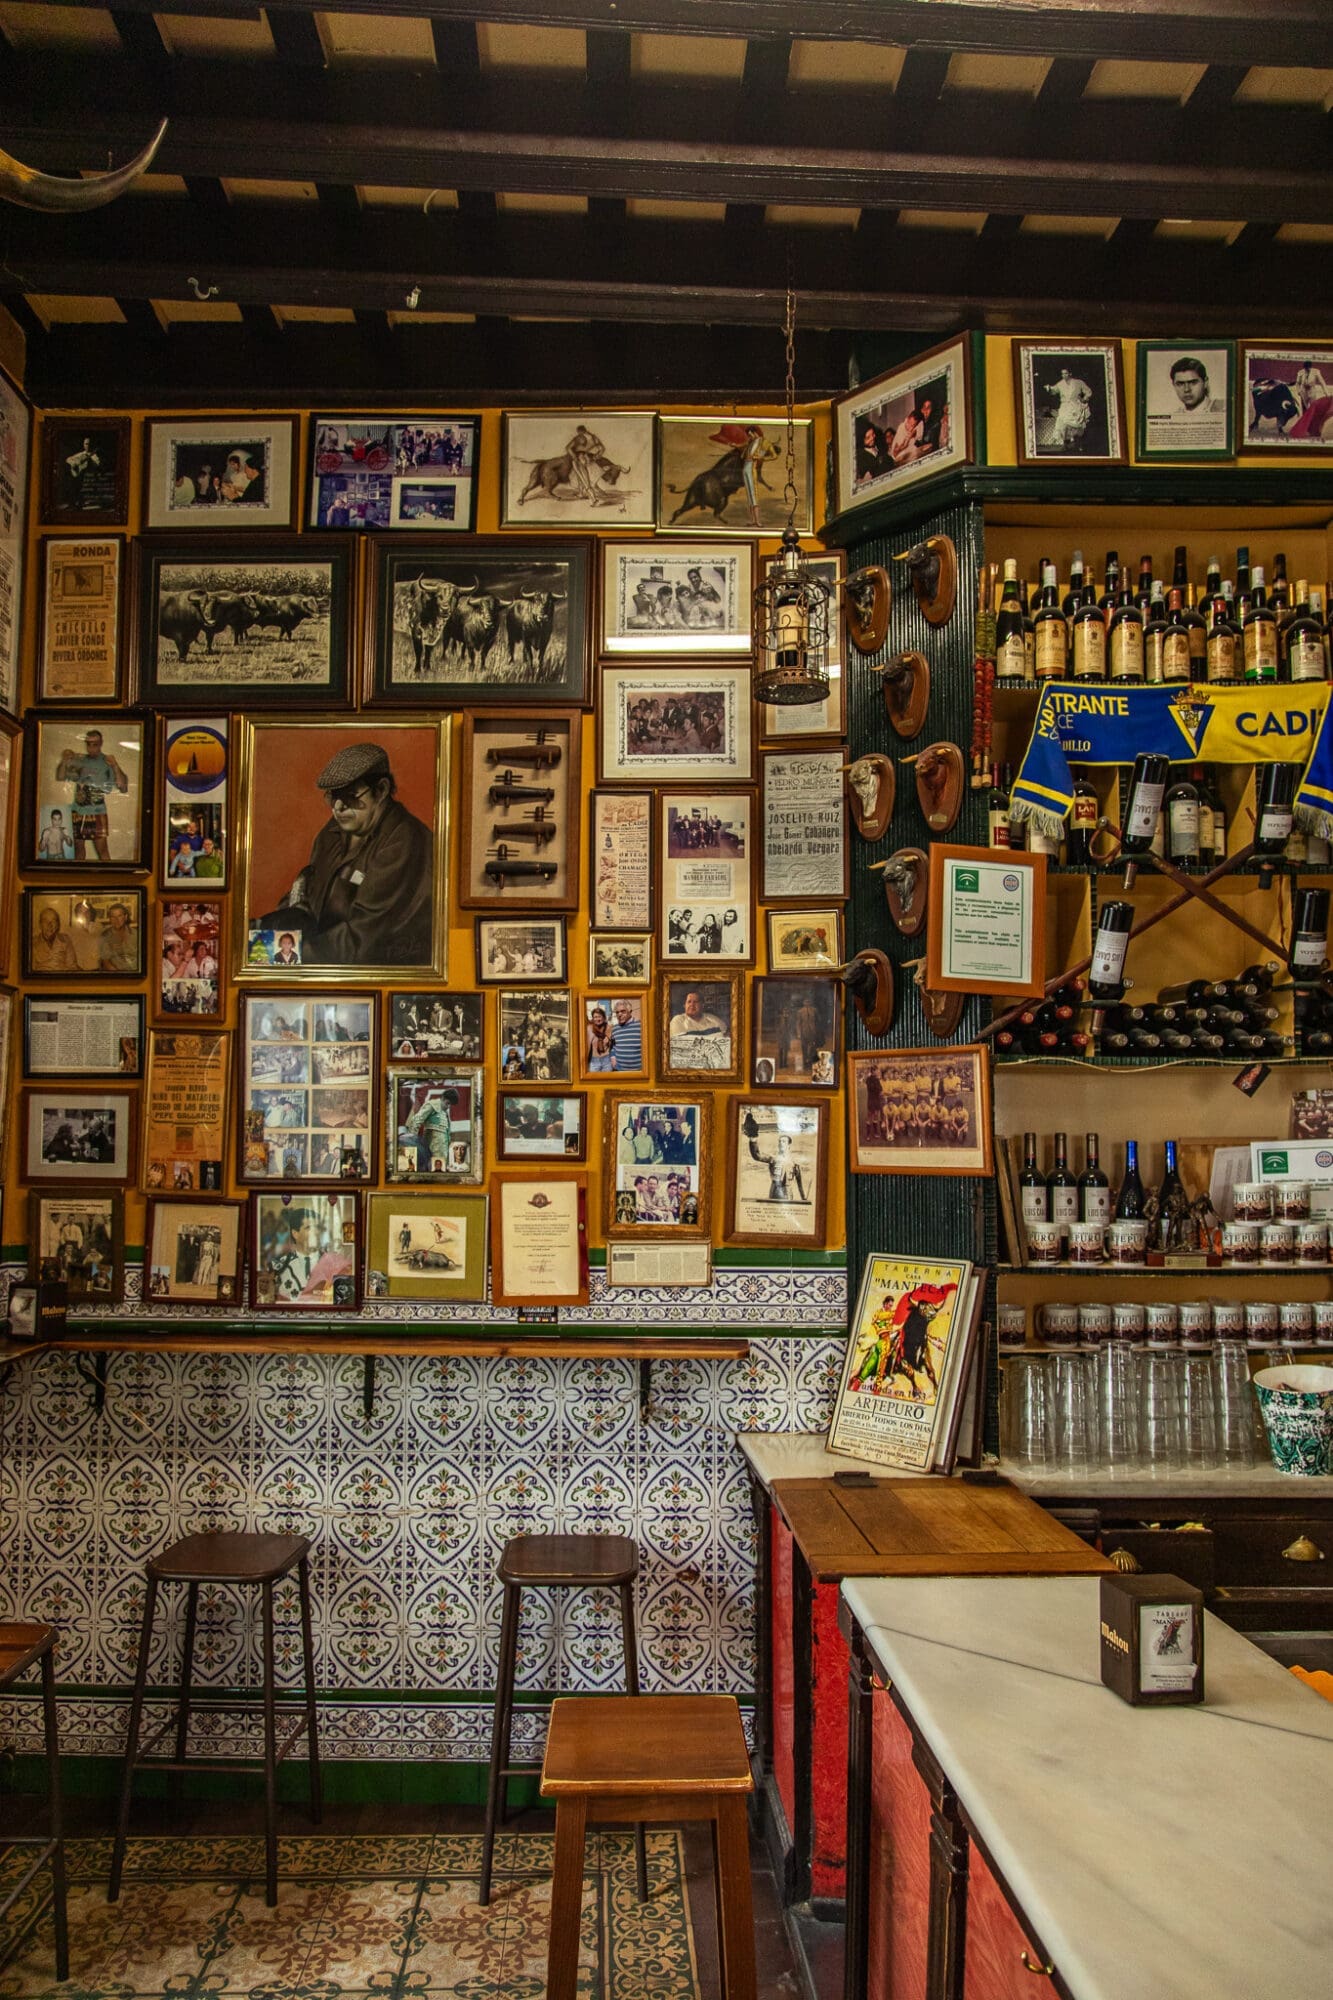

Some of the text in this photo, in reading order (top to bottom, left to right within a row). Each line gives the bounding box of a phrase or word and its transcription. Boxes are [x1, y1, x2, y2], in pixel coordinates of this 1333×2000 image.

[73, 546, 111, 557] RONDA
[55, 634, 105, 647] JAVIER CONDE
[768, 812, 840, 825] JOSELITO RUIZ
[884, 1263, 952, 1277] TABERNA
[853, 1396, 926, 1419] ARTEPURO
[841, 1409, 871, 1421] ABIERTO
[874, 1416, 898, 1426] TODOS
[900, 1421, 914, 1430] LOS
[1101, 1621, 1129, 1654] Mahou
